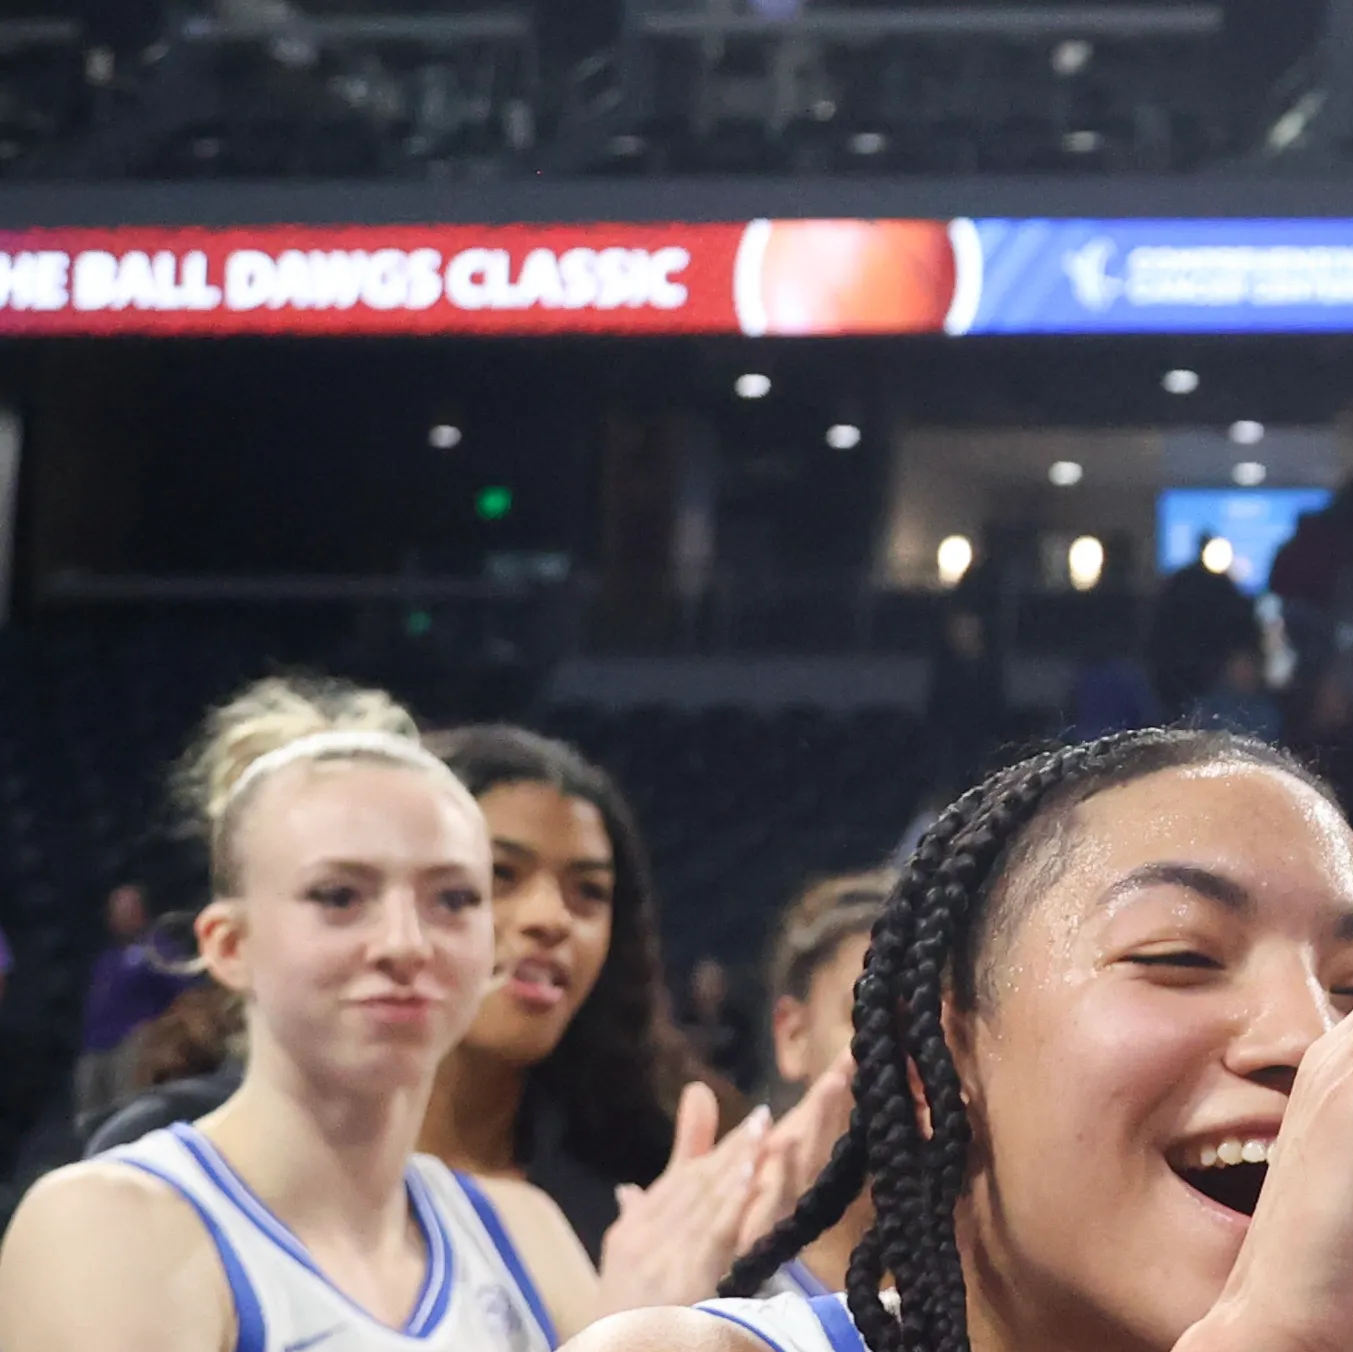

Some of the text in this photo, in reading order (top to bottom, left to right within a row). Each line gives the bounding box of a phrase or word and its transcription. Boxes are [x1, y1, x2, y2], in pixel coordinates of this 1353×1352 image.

[72, 248, 222, 311] BALL
[224, 248, 442, 311] DAWGS
[444, 246, 690, 311] CLASSIC
